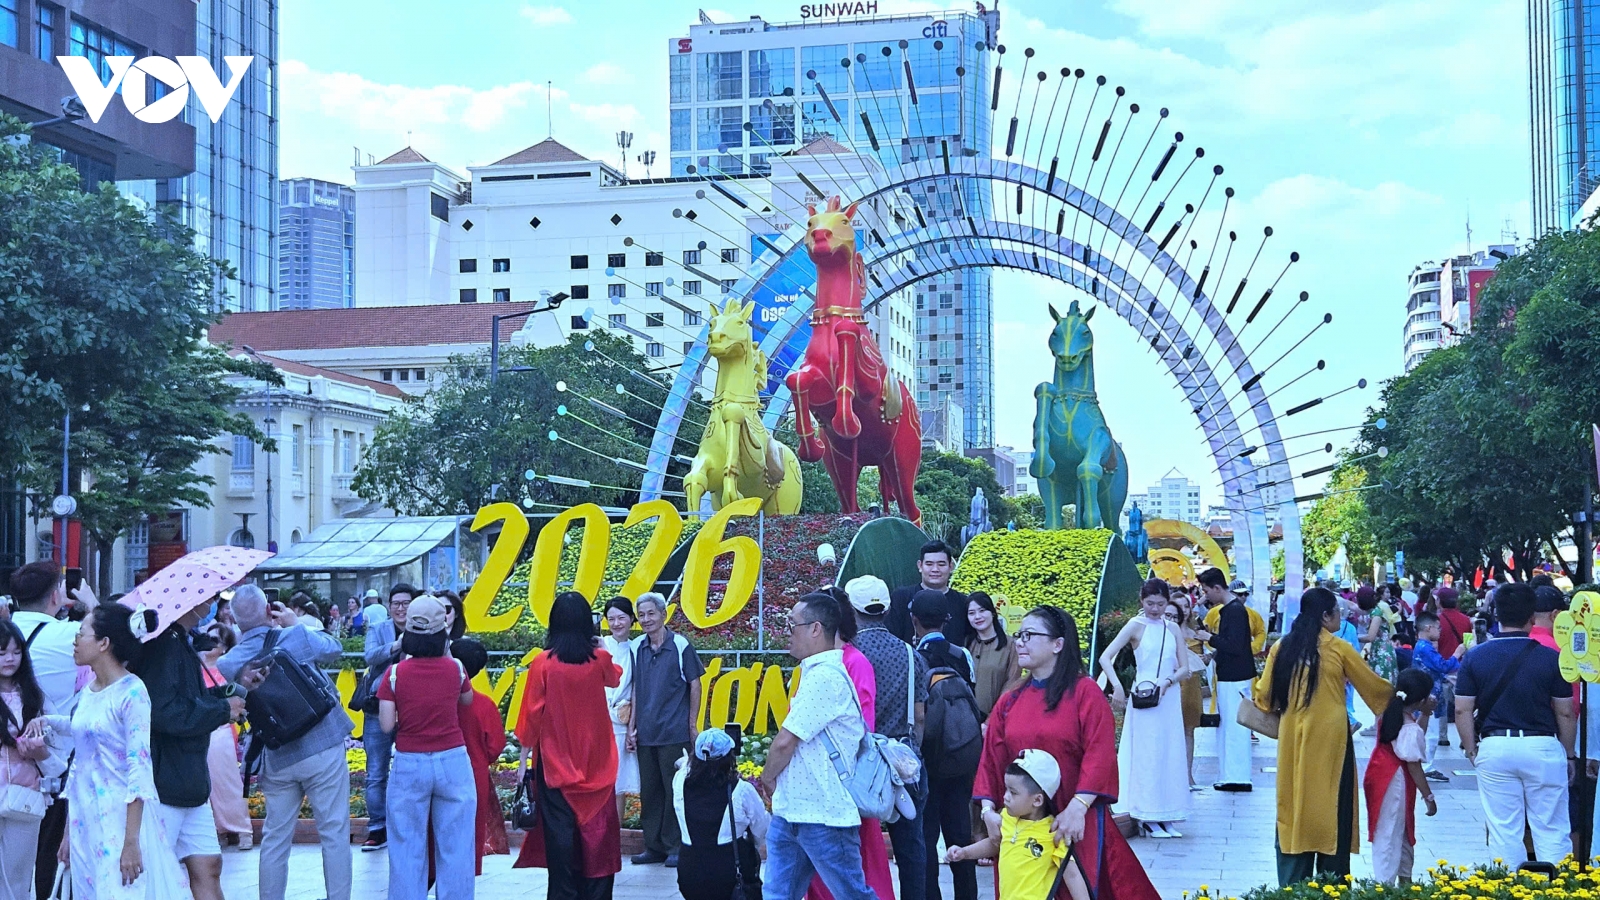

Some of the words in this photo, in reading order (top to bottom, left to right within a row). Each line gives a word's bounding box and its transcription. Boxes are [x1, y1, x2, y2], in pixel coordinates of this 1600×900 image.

[800, 1, 878, 18] SUNWAH
[922, 20, 948, 38] citi
[315, 195, 339, 206] Keppel
[463, 497, 764, 632] 2026
